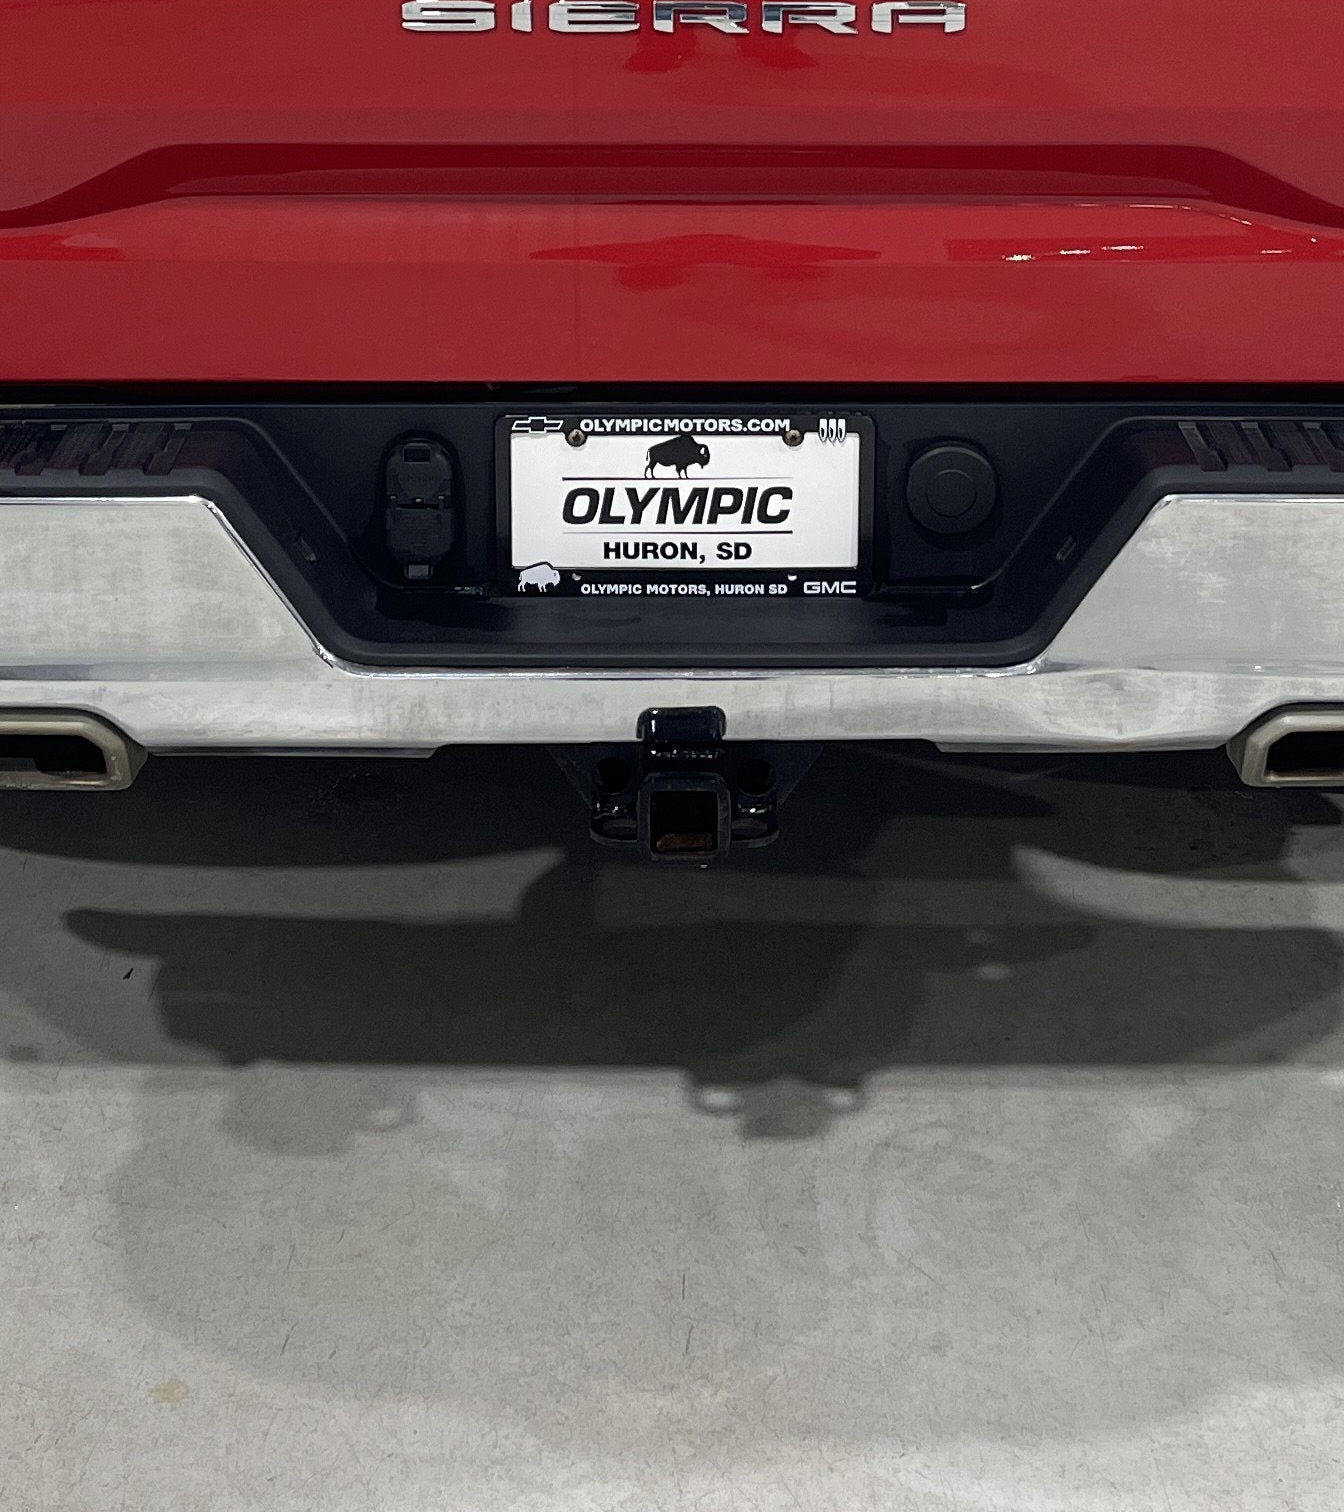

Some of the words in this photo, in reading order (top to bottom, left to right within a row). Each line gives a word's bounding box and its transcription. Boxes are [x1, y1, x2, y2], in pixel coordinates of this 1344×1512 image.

[579, 418, 791, 432] OLYMPICMOTORS.COM
[562, 486, 794, 525] OLYMPIC
[603, 542, 706, 564] HURON,
[716, 541, 753, 561] SD
[580, 583, 644, 595] OLYMPIC
[646, 584, 711, 597] MOTORS,
[714, 584, 766, 595] HURON
[768, 584, 788, 594] SD
[803, 581, 857, 594] GMC
